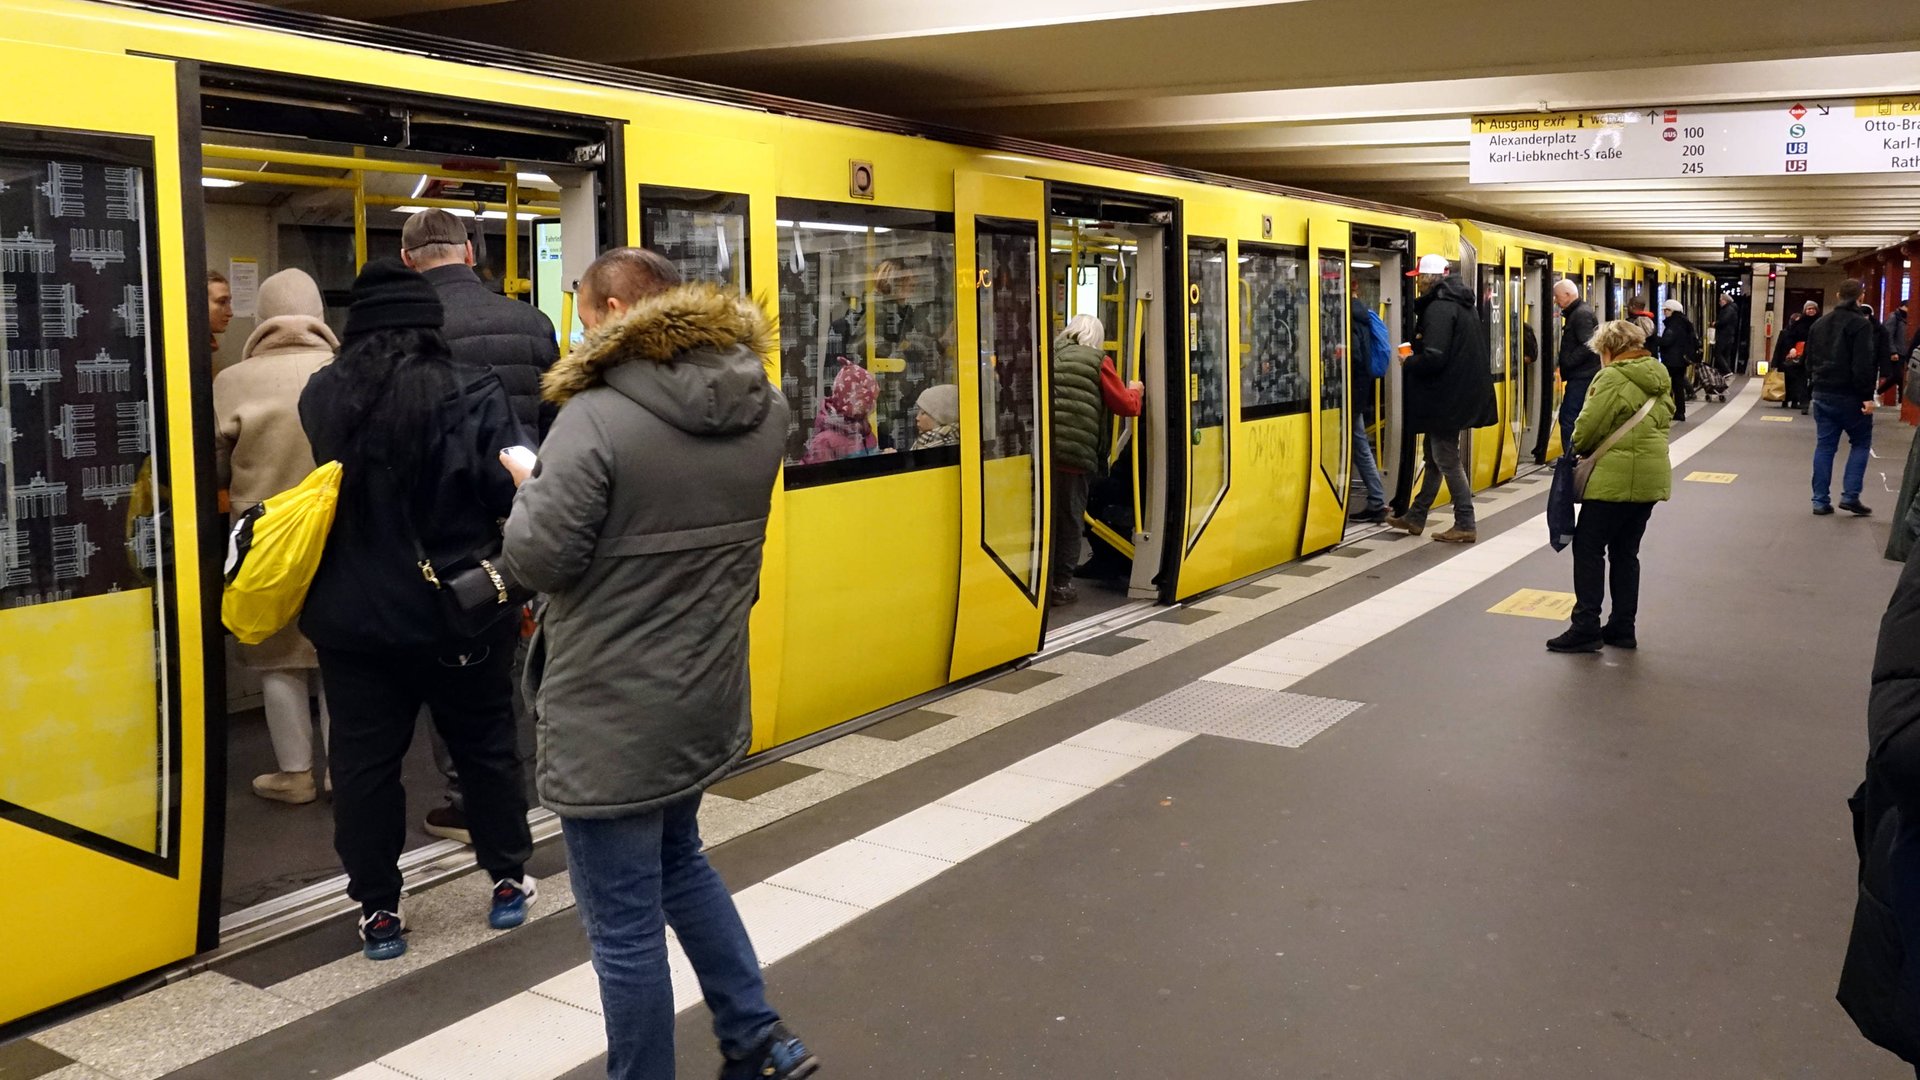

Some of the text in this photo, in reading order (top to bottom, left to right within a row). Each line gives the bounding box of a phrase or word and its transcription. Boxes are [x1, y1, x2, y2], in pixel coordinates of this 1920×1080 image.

[1489, 118, 1539, 131] Ausgang
[1543, 116, 1567, 127] exit
[1683, 127, 1705, 139] 100
[1489, 133, 1577, 147] Alexanderplatz
[1682, 145, 1705, 157] 200
[1788, 143, 1806, 154] U8
[1489, 148, 1623, 164] Karl-Liebknecht-Sraße
[1681, 162, 1704, 175] 245
[1787, 160, 1806, 171] U5
